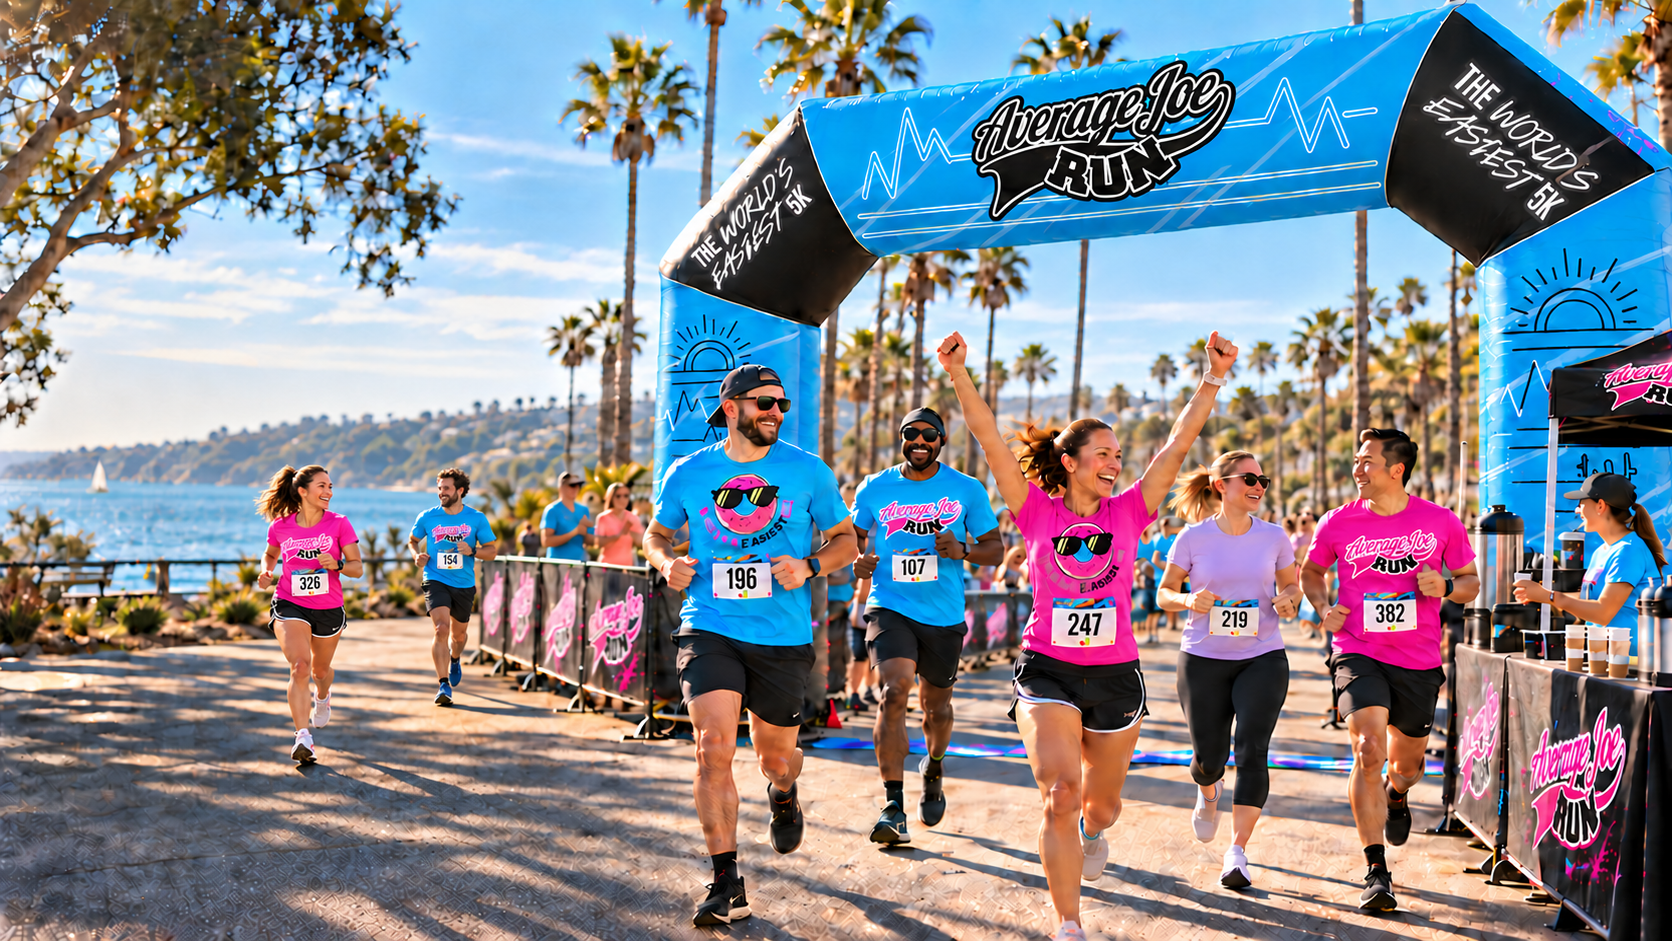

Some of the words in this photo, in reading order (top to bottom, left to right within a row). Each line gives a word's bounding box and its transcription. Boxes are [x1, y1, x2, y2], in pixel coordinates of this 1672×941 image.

[974, 86, 1146, 163] Average
[1132, 62, 1222, 138] Joe
[1454, 62, 1501, 111] THE
[1490, 100, 1599, 190] WORLD'S
[1043, 134, 1178, 199] RUN
[1423, 97, 1544, 189] EASIEST
[1527, 181, 1565, 220] 5K
[691, 234, 722, 268] THE
[720, 157, 793, 245] WORLD'S
[711, 200, 783, 290] EASIEST
[785, 183, 813, 215] 5K
[741, 514, 788, 549] EASIEST
[902, 517, 946, 536] RUN
[726, 566, 758, 590] 196
[901, 558, 926, 576] 107
[1370, 553, 1420, 575] RUN
[299, 575, 321, 591] 326
[1067, 612, 1103, 637] 247
[1221, 610, 1248, 629] 219
[1375, 603, 1405, 624] 382
[1584, 706, 1624, 788] Joe
